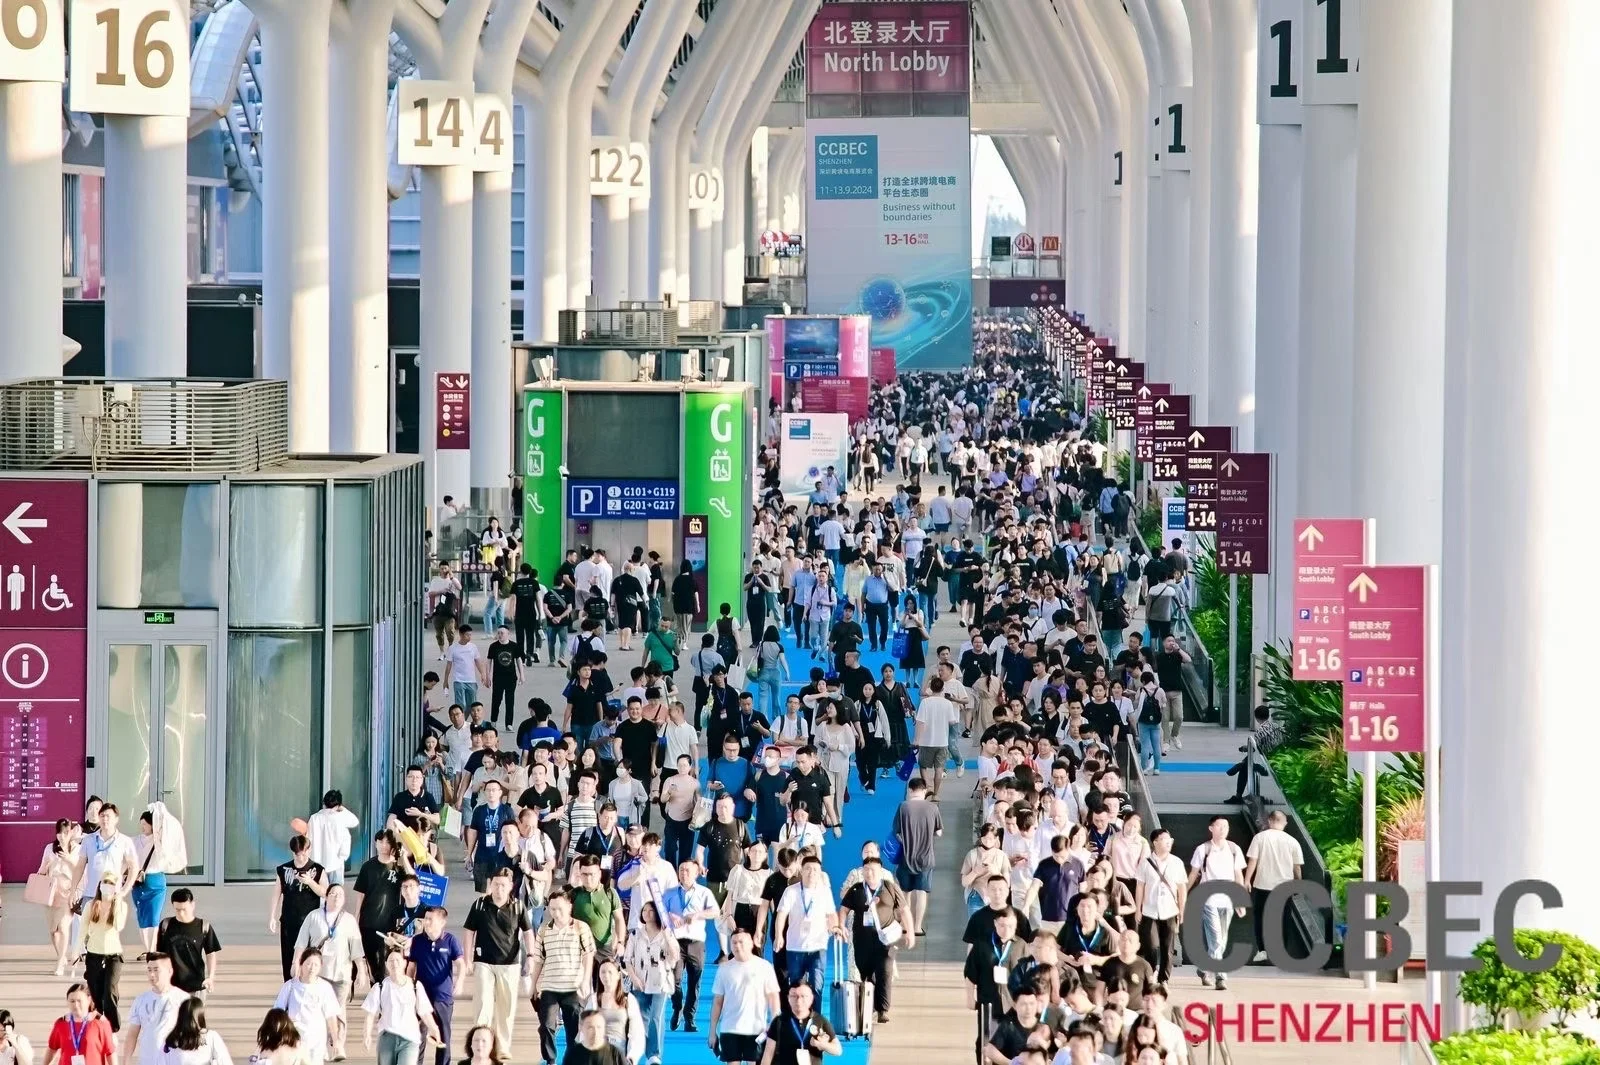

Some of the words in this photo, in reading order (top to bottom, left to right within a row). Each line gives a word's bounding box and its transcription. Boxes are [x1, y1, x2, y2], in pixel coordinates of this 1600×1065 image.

[824, 20, 950, 44] 北登录大厅
[96, 8, 174, 88] 16
[824, 50, 883, 73] North
[890, 50, 950, 77] Lobby
[413, 97, 464, 148] 14
[818, 142, 868, 156] CCBEC
[590, 148, 624, 183] 12
[882, 176, 956, 186] 打造全球跨境电商
[820, 185, 873, 195] 11-13.9.2024
[882, 187, 929, 198] 平台生态圈
[883, 203, 921, 211] Business
[922, 202, 956, 211] without
[883, 213, 932, 221] boundaries
[884, 233, 917, 245] 13-16
[527, 398, 545, 437] G
[710, 403, 732, 443] G
[1116, 416, 1134, 427] 1-12
[1155, 465, 1178, 477] 1-14
[623, 487, 647, 497] G101
[653, 487, 676, 497] G119
[580, 489, 594, 512] P
[623, 500, 647, 510] G201
[653, 500, 676, 510] G217
[1188, 511, 1216, 526] 1-14
[1220, 551, 1252, 567] 1-14
[1317, 575, 1335, 584] Lobby
[1349, 631, 1370, 639] South
[1370, 631, 1391, 641] Lobby
[1298, 648, 1341, 670] 1-16
[1349, 715, 1399, 742] 1-16
